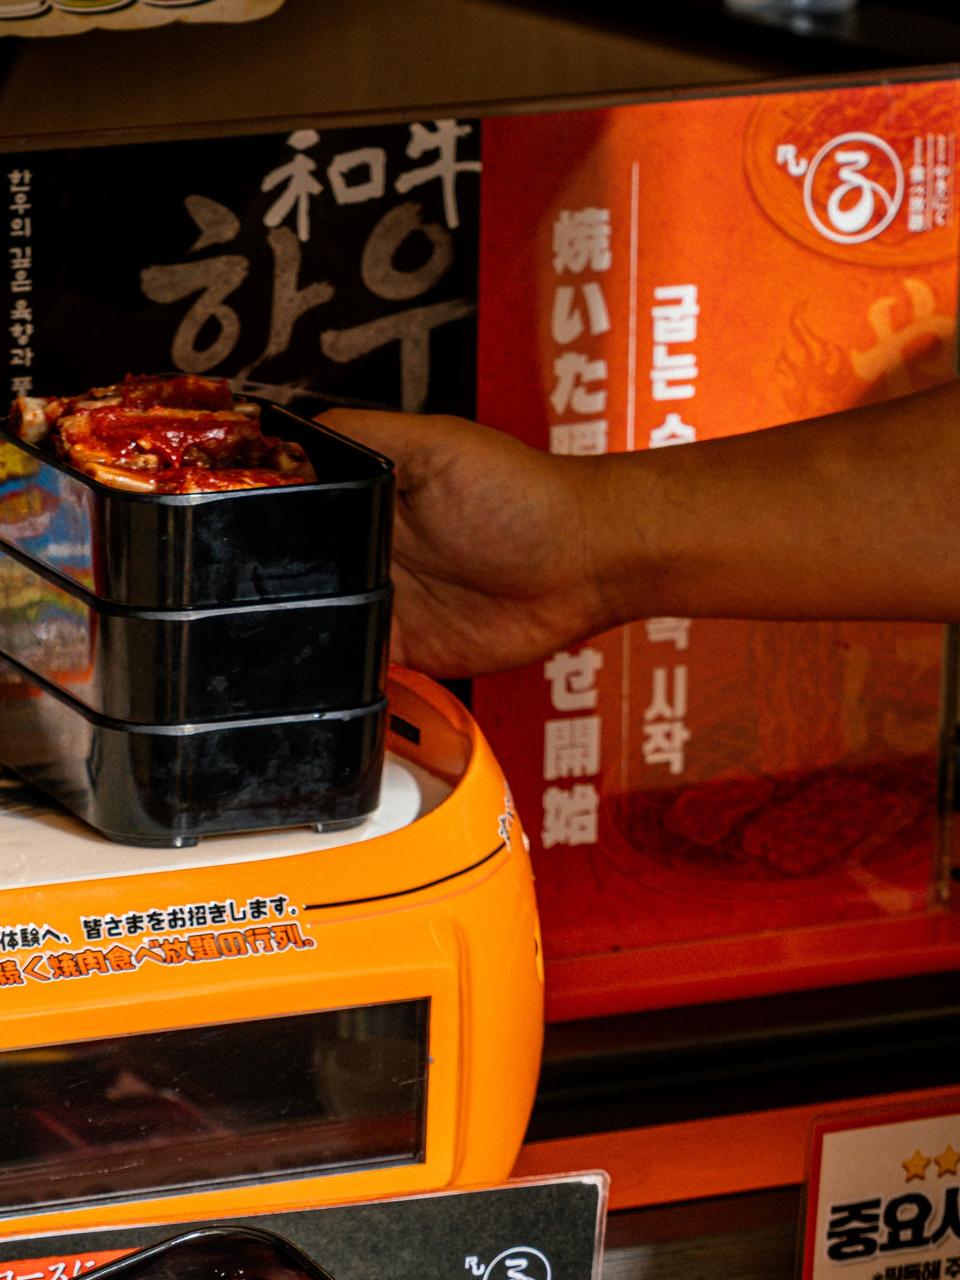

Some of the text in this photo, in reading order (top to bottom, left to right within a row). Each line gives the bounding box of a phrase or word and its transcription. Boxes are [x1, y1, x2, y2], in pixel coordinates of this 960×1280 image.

[7, 169, 33, 238] 한우의
[261, 119, 481, 242] 和牛
[642, 664, 691, 775] 시작
